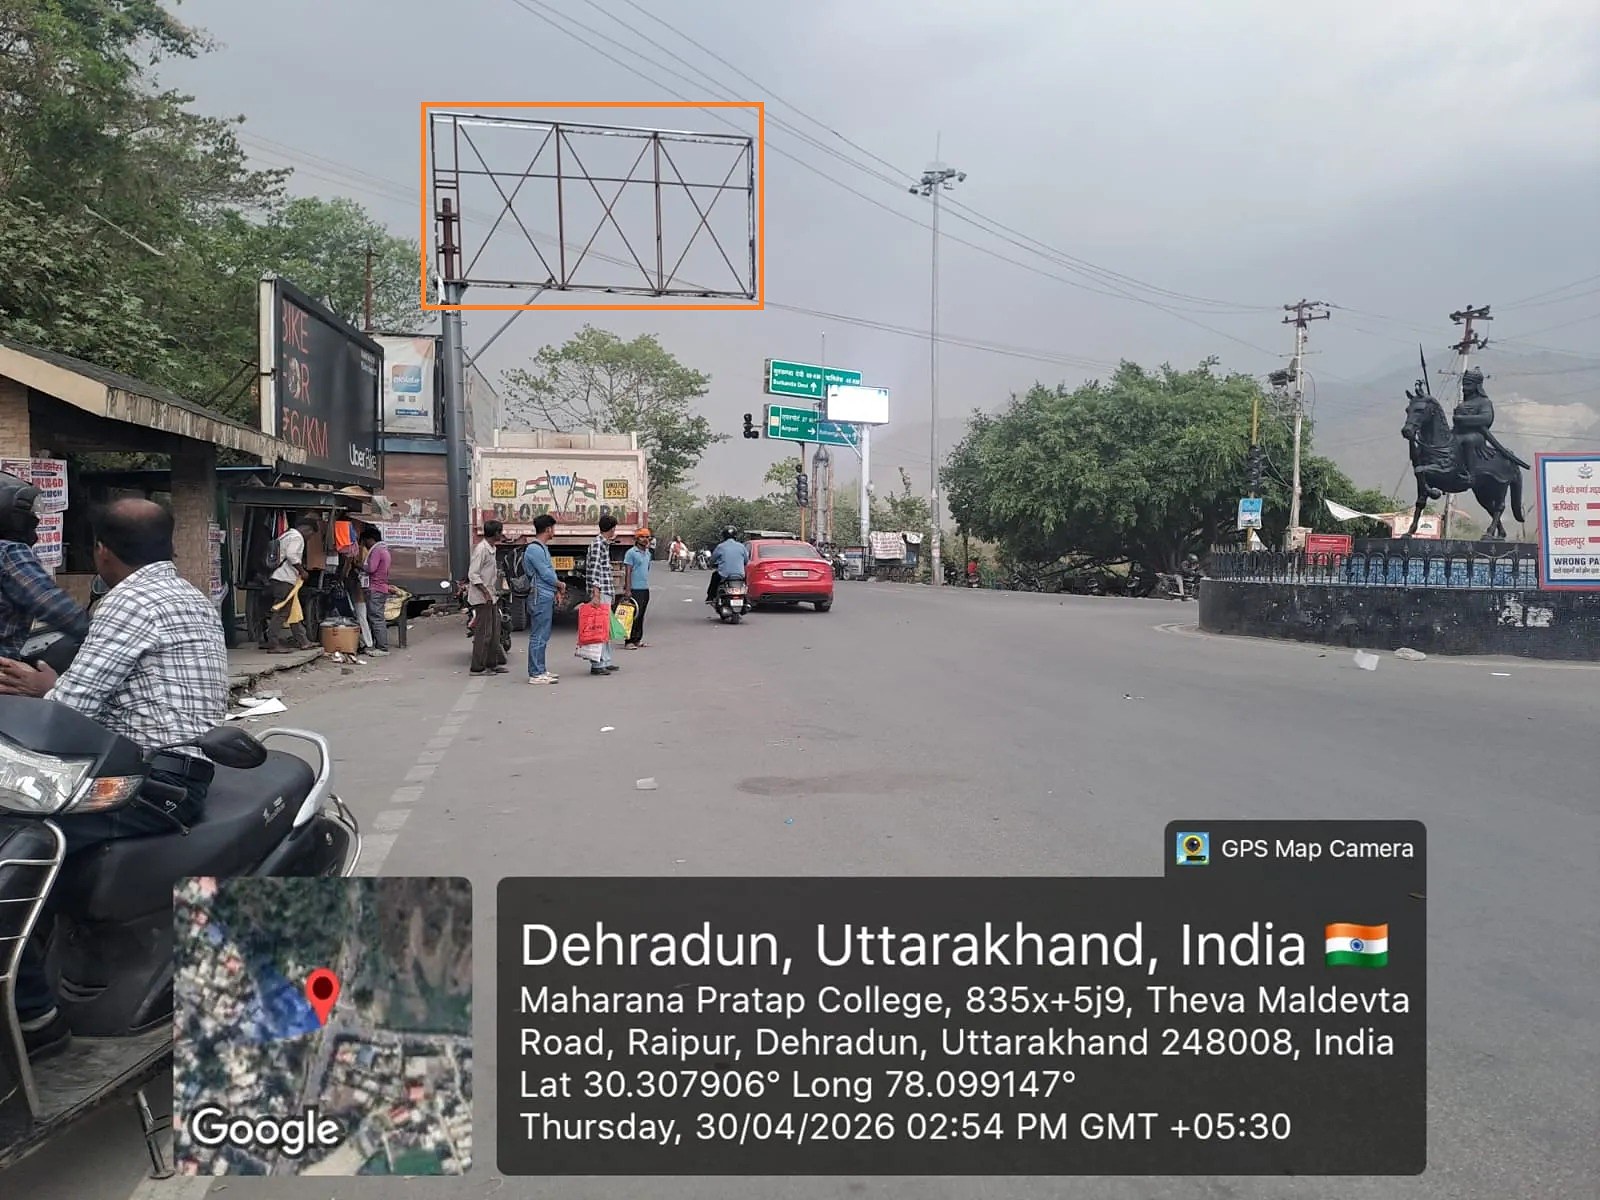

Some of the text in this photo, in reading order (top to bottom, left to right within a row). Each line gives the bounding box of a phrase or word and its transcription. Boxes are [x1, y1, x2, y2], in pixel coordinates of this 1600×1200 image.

[282, 354, 311, 405] OR
[551, 476, 571, 486] TATA
[494, 503, 549, 522] BLOW
